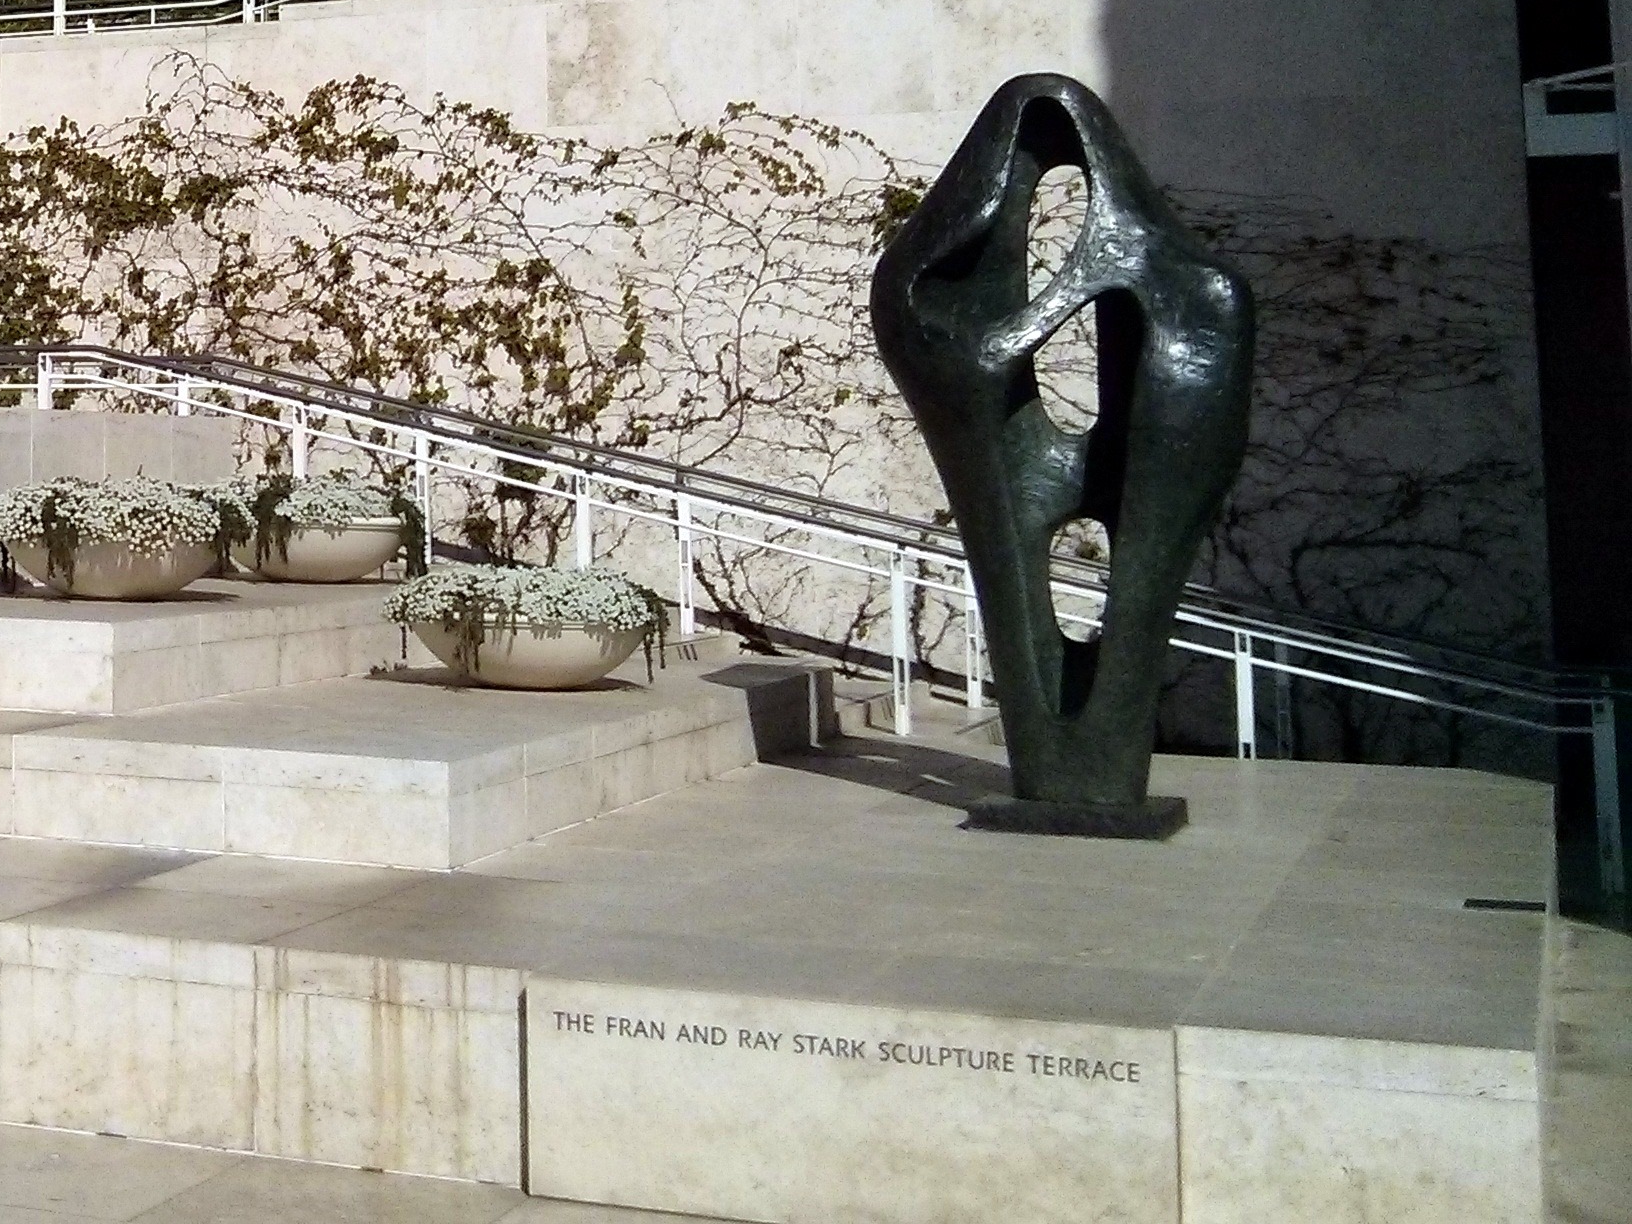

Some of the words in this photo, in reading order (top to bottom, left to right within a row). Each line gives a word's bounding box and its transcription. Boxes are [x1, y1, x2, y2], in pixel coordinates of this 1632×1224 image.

[553, 1011, 594, 1033] THE
[606, 1016, 665, 1040] FRAN
[676, 1023, 727, 1045] AND
[738, 1029, 783, 1051] RAY
[793, 1033, 865, 1059] STARK
[878, 1040, 1014, 1072] SCULPTURE
[1027, 1054, 1141, 1082] TERRACE
